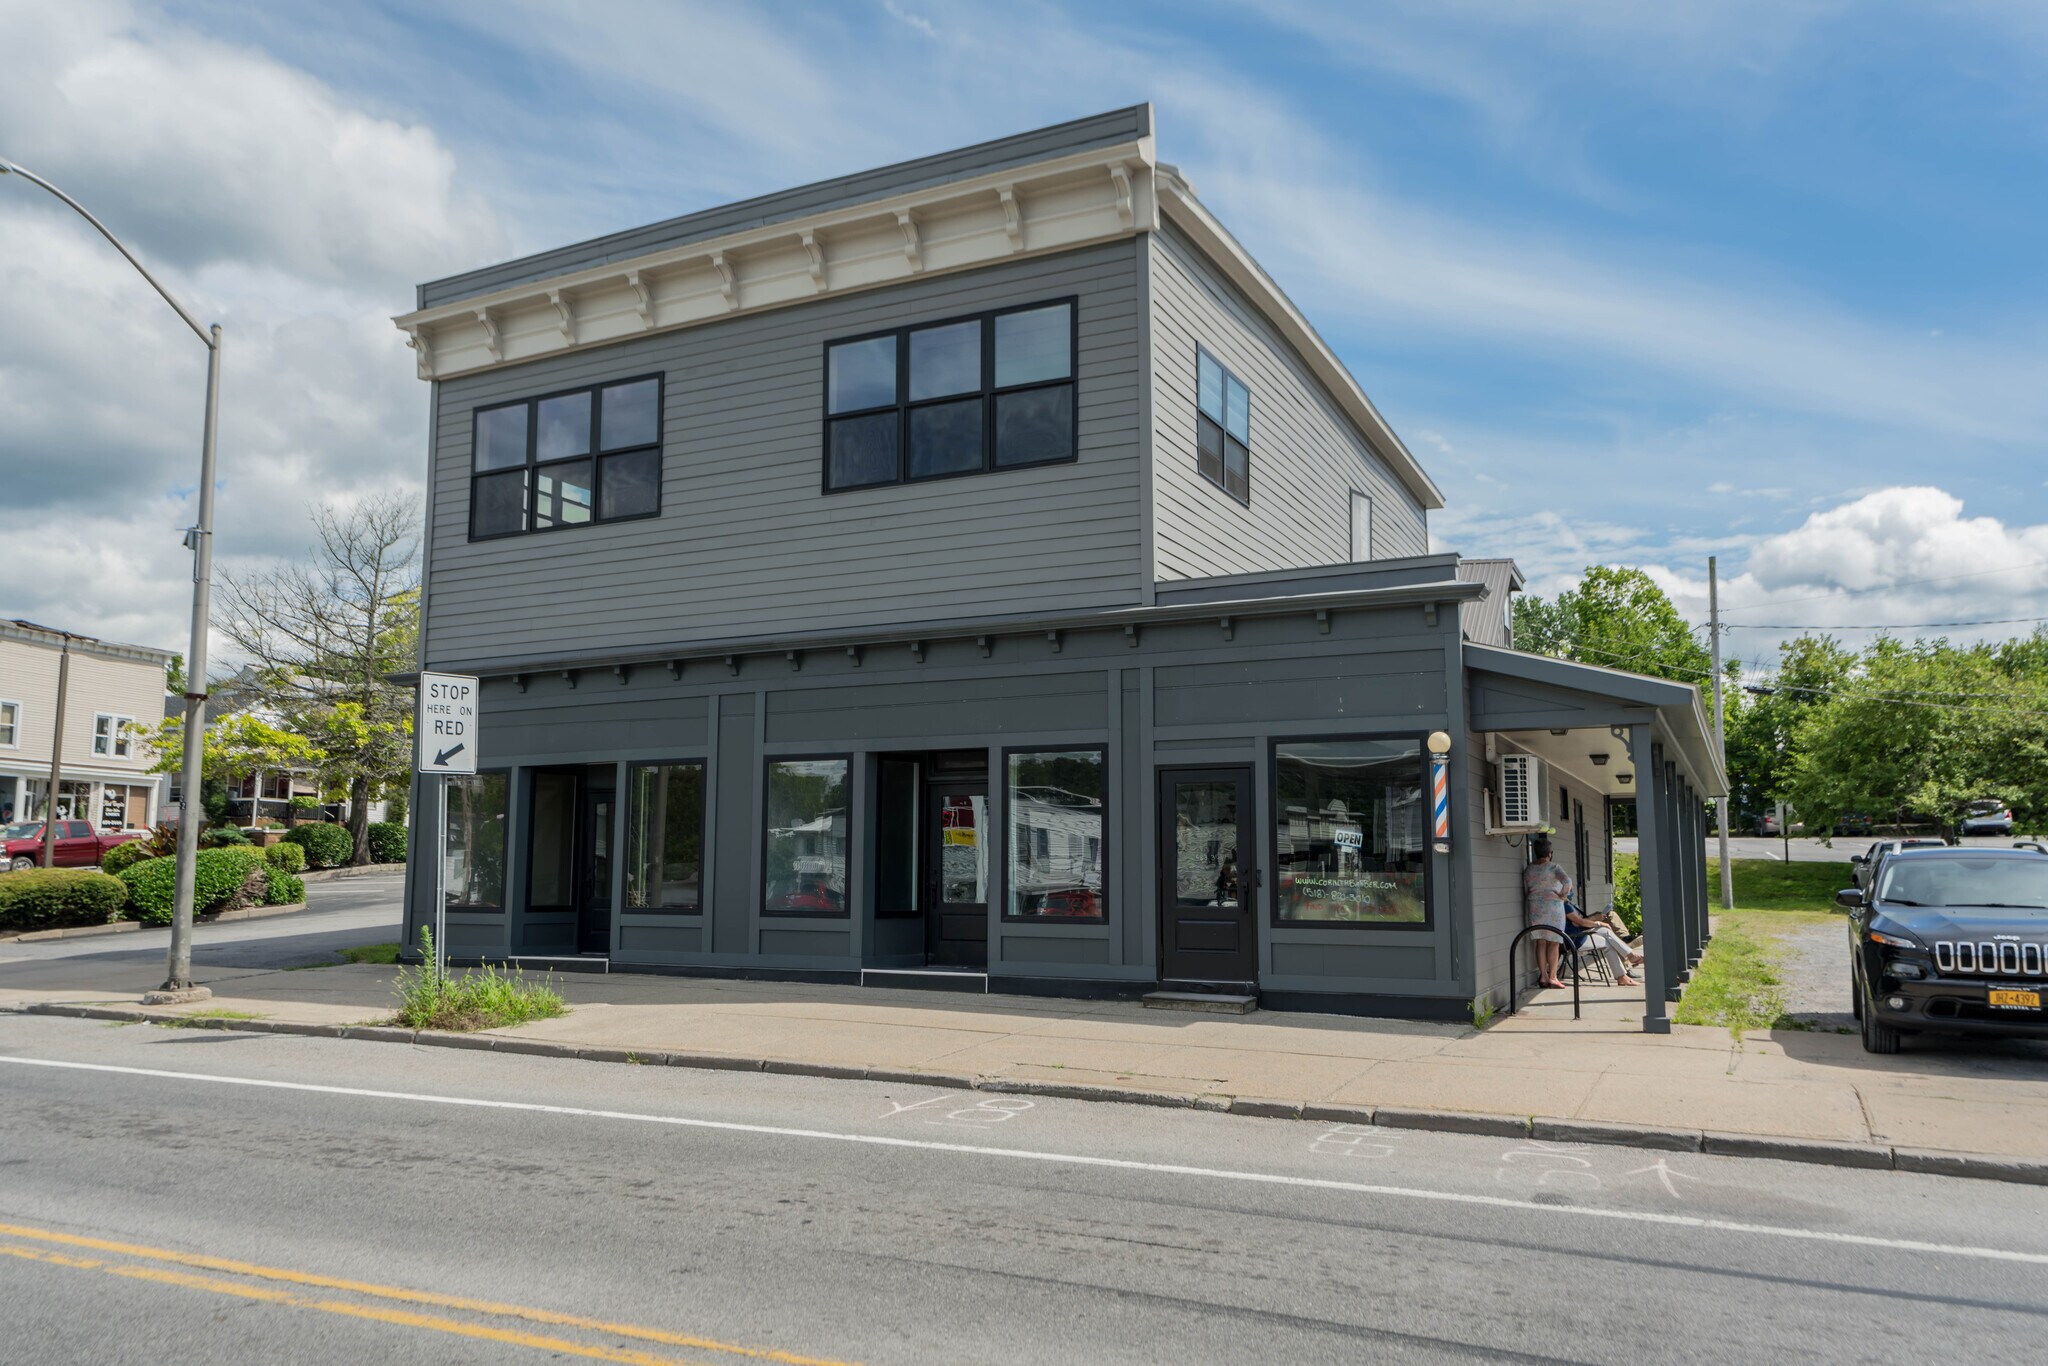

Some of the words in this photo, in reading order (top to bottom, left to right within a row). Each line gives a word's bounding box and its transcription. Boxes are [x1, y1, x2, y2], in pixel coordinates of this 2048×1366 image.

[430, 683, 470, 701] STOP
[427, 704, 452, 715] HERE
[460, 706, 473, 717] ON
[434, 720, 464, 736] RED
[1336, 832, 1362, 846] OPEN
